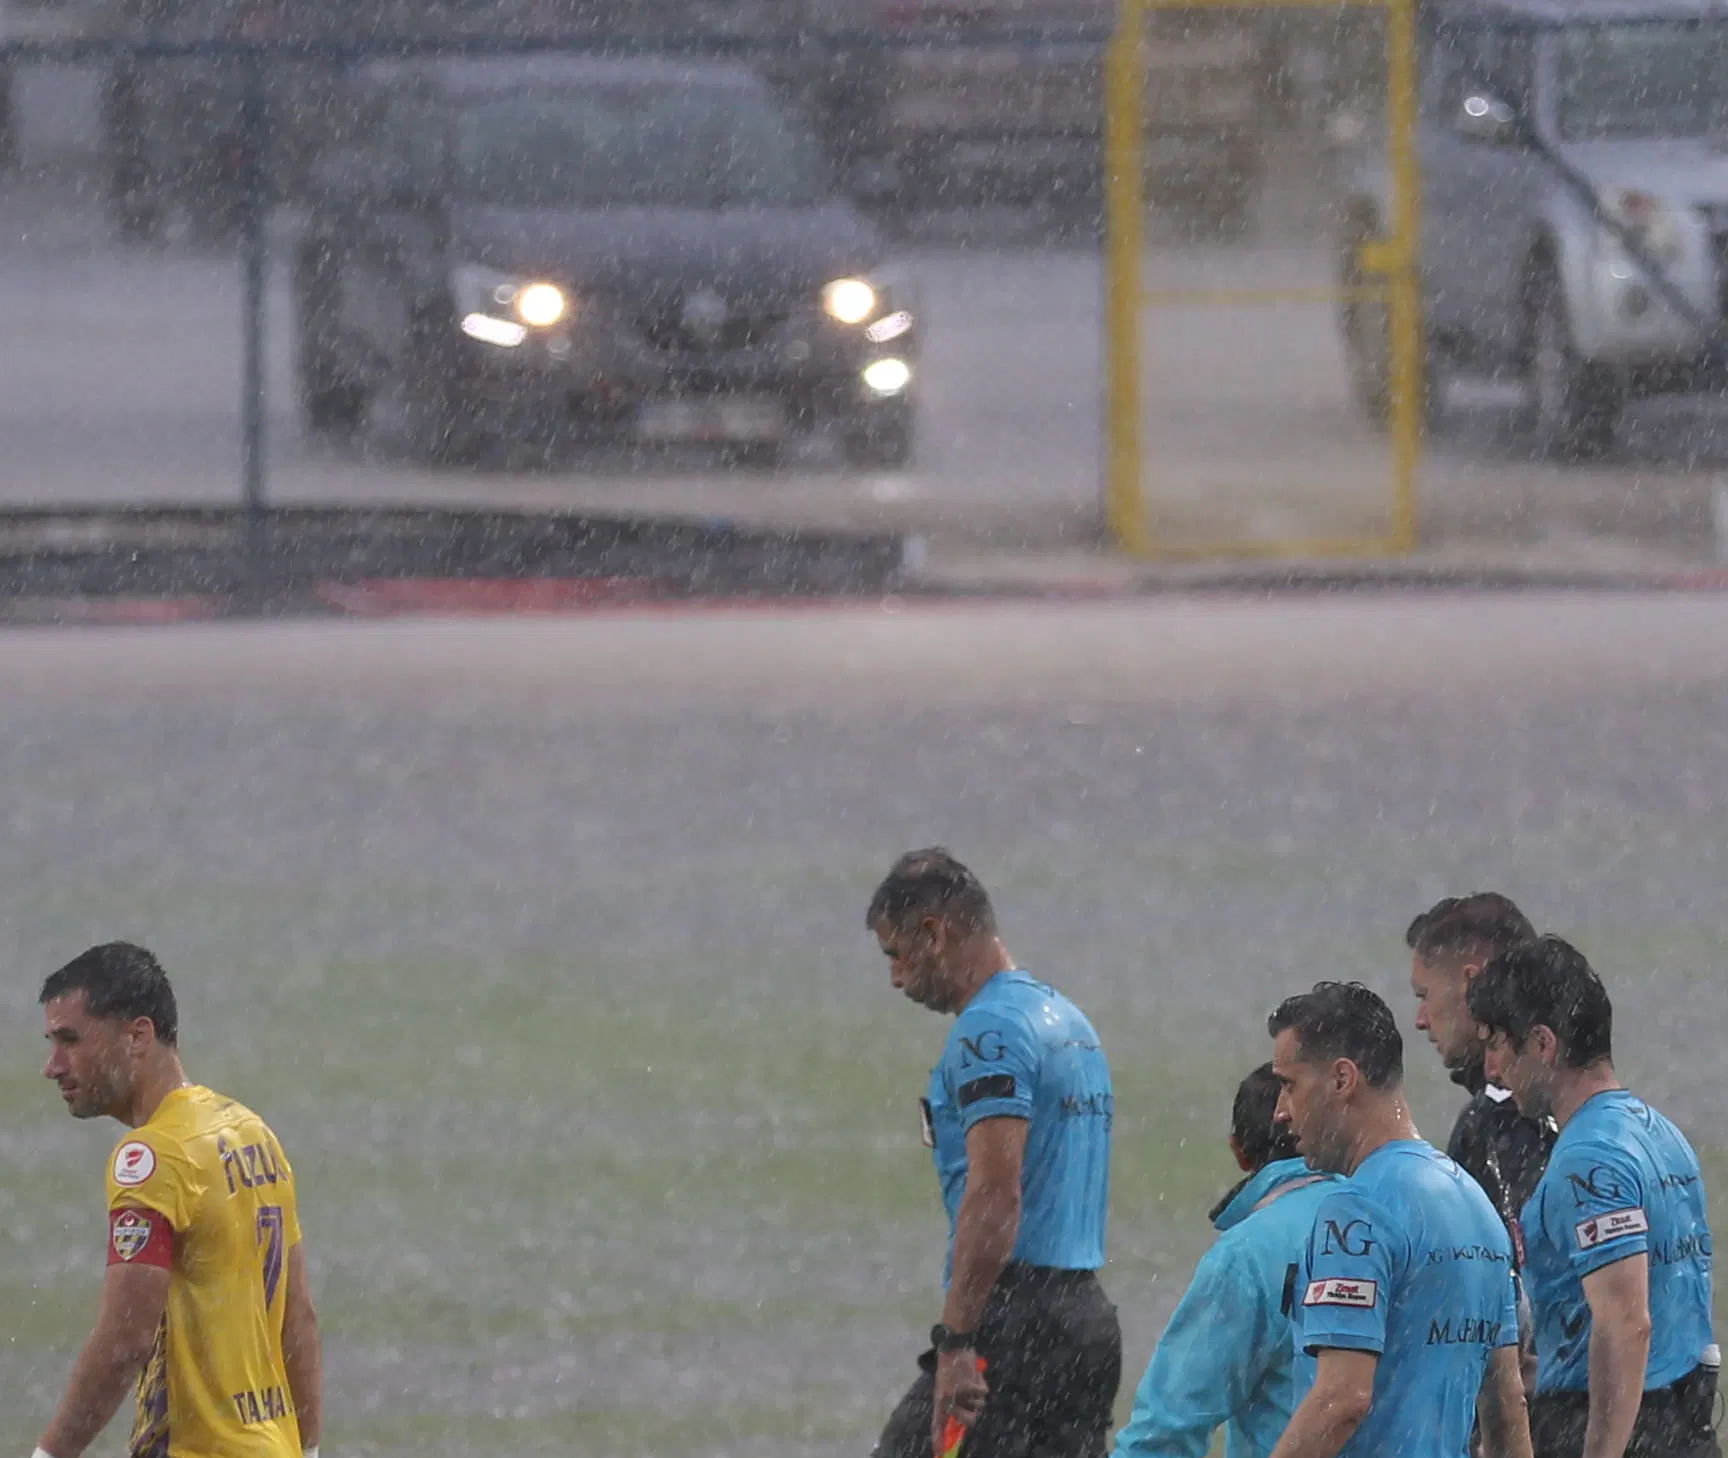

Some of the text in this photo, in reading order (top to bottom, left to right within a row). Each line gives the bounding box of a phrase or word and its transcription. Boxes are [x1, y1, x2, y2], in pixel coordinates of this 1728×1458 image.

[959, 1030, 1008, 1069] NG
[1320, 1219, 1377, 1256] NG
[256, 1206, 284, 1313] 7
